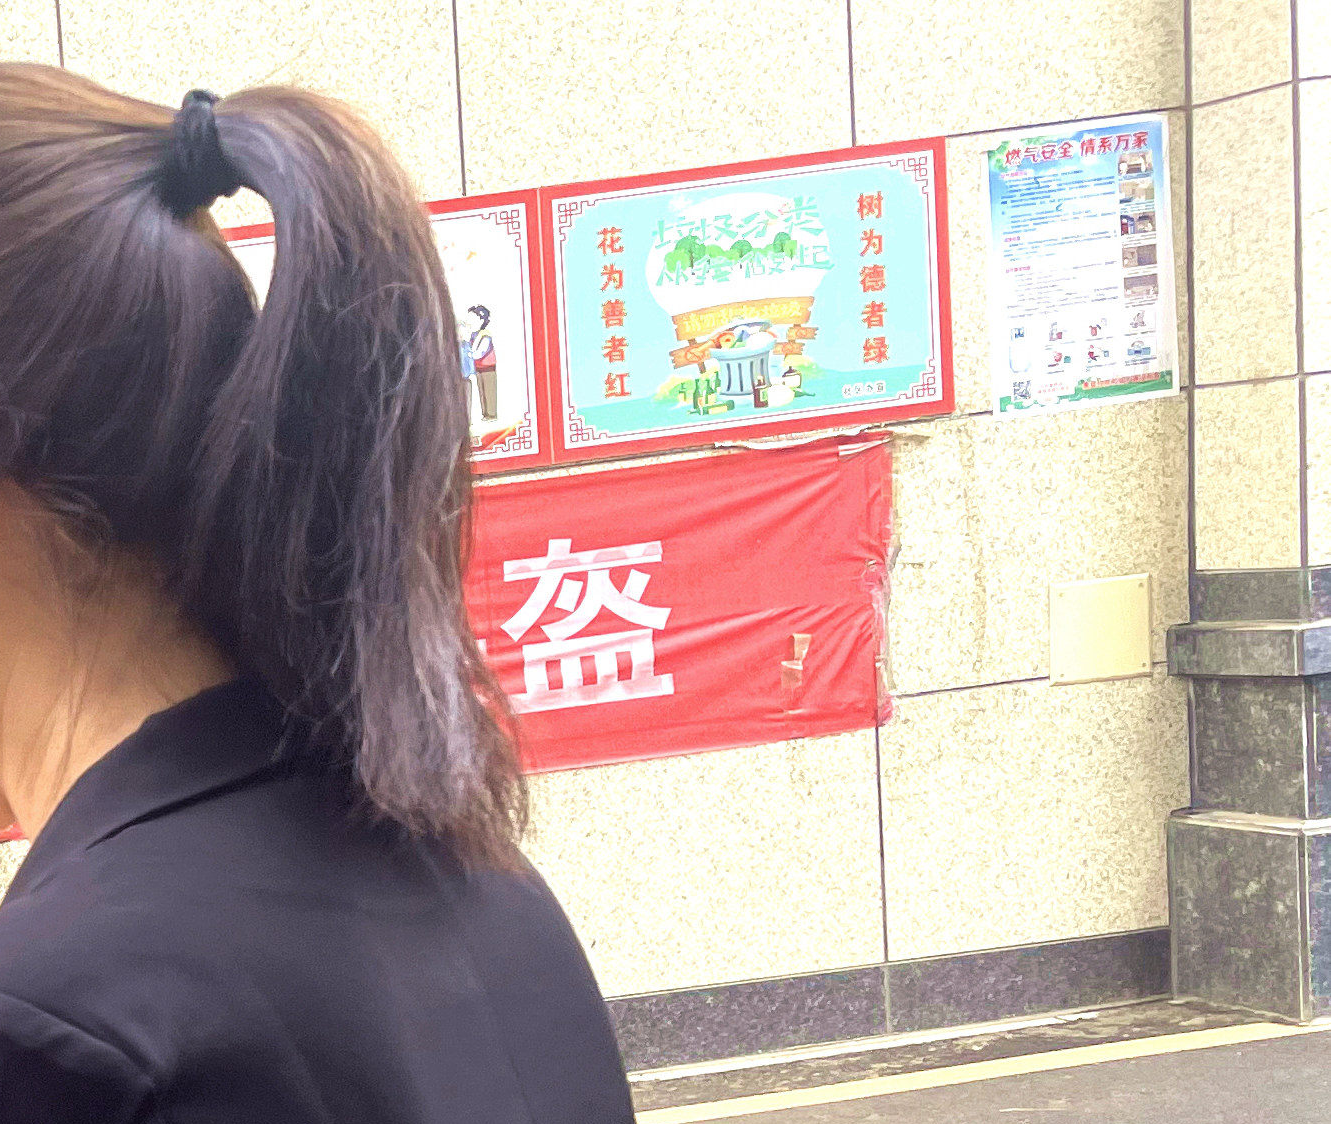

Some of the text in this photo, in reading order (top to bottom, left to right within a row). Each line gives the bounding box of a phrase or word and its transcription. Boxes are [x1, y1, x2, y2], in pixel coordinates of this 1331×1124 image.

[1004, 131, 1149, 166] 燃气安全 情系万家
[596, 227, 632, 399] 花为善者红
[856, 191, 890, 364] 树为德者绿
[475, 538, 675, 715] 盔
